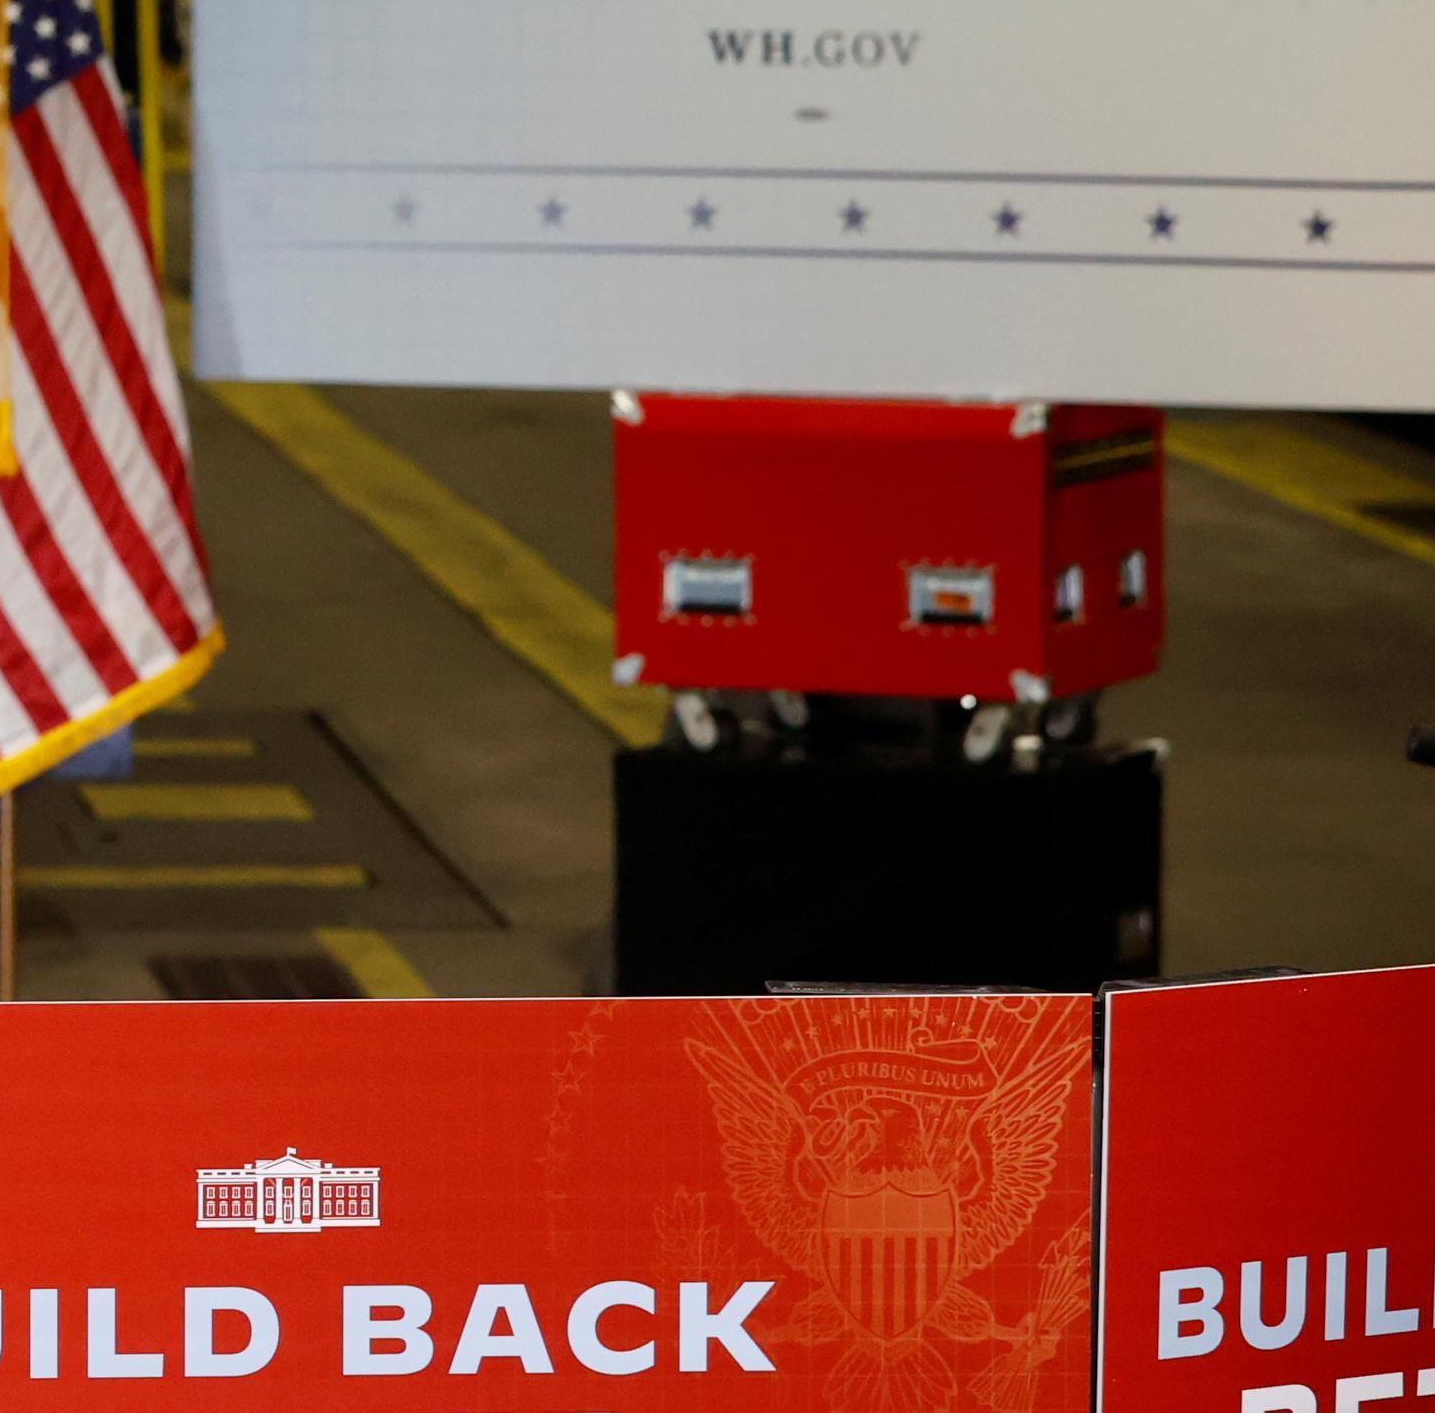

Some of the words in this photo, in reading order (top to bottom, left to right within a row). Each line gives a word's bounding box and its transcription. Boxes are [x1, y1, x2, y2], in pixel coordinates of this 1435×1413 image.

[707, 28, 920, 69] WH.GOV
[816, 1061, 917, 1086] PLURIBUS
[921, 1069, 985, 1090] UNUM
[341, 1279, 777, 1377] BACK
[1157, 1246, 1435, 1360] BUIL
